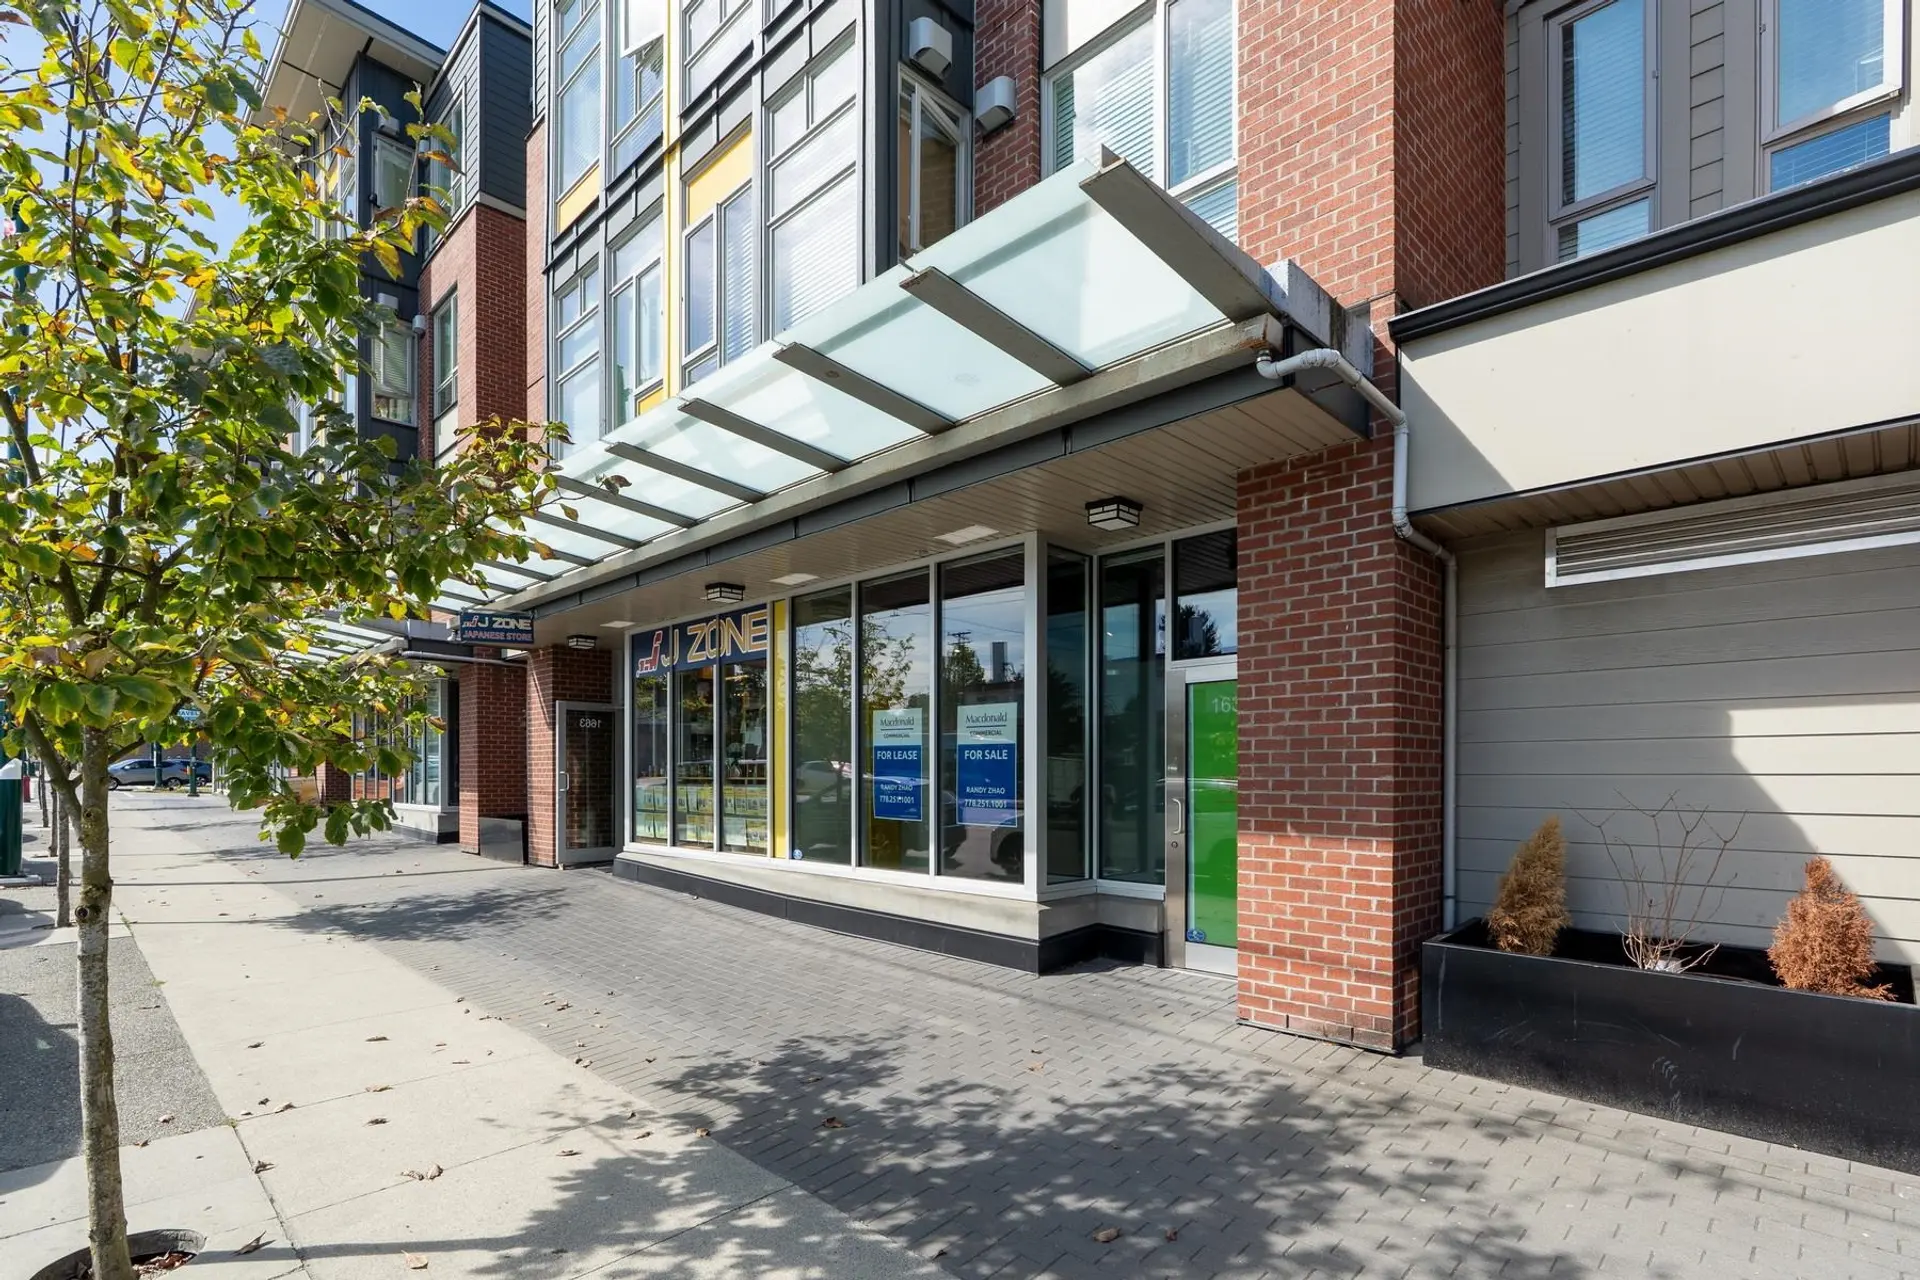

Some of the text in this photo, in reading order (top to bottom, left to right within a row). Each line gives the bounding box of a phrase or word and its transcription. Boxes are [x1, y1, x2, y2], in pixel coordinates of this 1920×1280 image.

[477, 616, 532, 631] J ZONE
[463, 630, 533, 641] JAPANESE STORE
[660, 609, 768, 667] J ZONE
[880, 717, 914, 726] Macdonald
[966, 712, 1007, 723] Macdonald
[876, 750, 918, 760] FOR LEASE
[964, 749, 1008, 760] FOR SALE
[966, 786, 1006, 795] RANDY ZHAO
